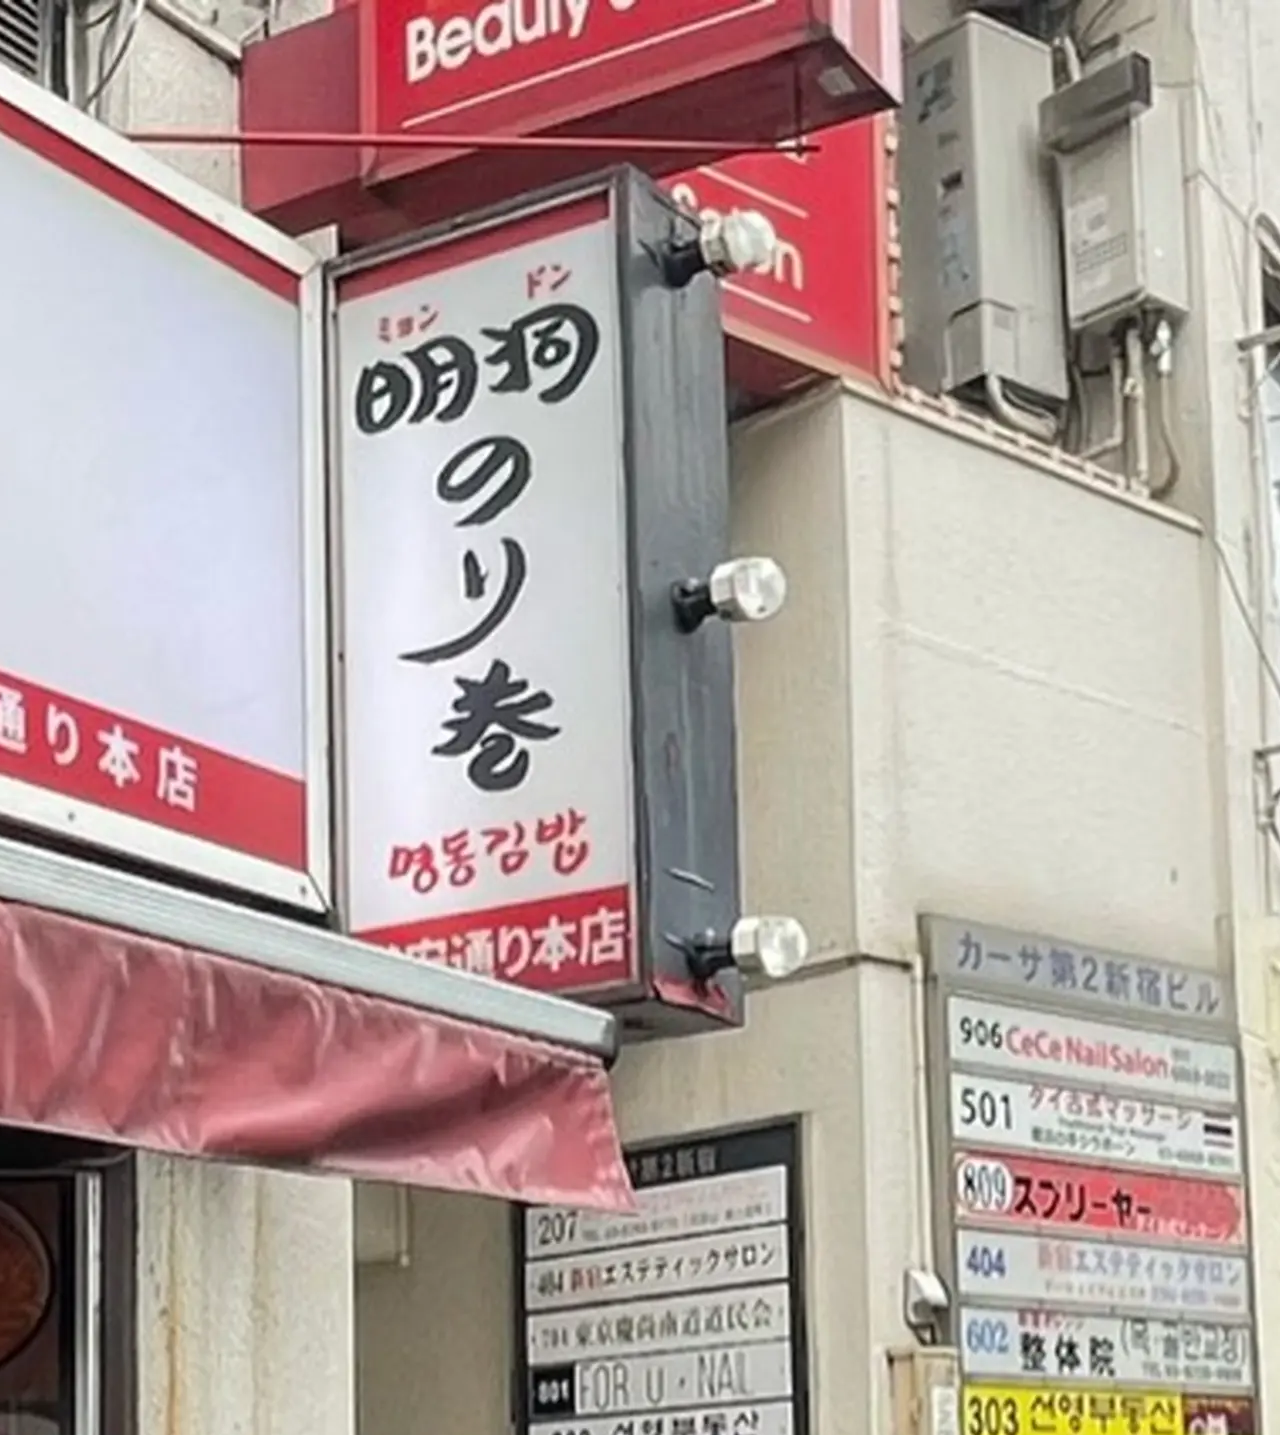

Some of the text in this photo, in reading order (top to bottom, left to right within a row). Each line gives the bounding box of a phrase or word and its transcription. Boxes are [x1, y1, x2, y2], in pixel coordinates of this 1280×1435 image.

[527, 265, 572, 299] ドン
[376, 305, 440, 342] ミョン
[388, 808, 588, 893] 명동김밥
[959, 932, 1220, 1014] カーサ第2新宿ビル
[959, 1016, 1003, 1050] 906
[961, 1088, 1012, 1129] 501
[963, 1163, 1008, 1210] 809
[538, 1212, 579, 1247] 207
[967, 1246, 1006, 1277] 404
[965, 1318, 1009, 1353] 602
[1022, 1332, 1115, 1377] 整体院
